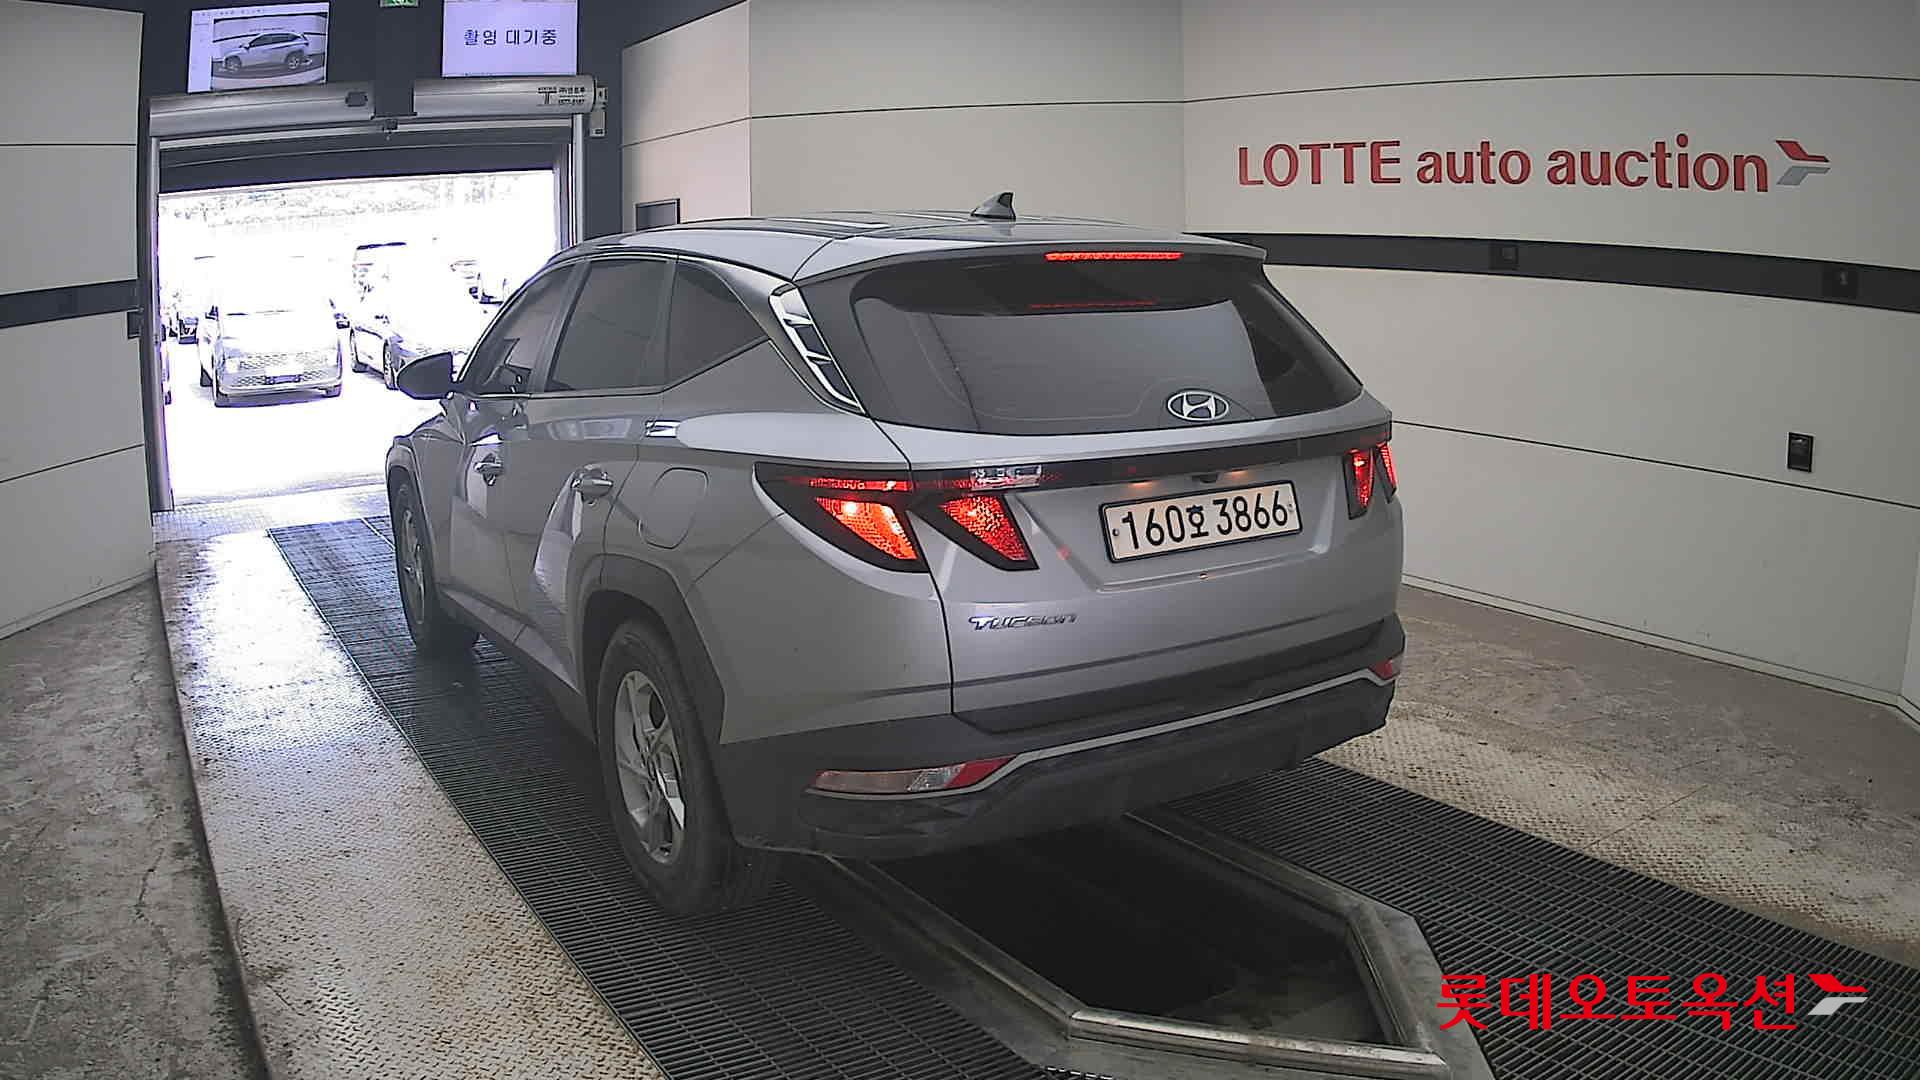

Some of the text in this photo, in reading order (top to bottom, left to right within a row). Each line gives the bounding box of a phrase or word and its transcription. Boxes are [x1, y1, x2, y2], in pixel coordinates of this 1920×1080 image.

[464, 29, 557, 46] 촬영 대기중
[1239, 133, 1769, 192] LOTTE auto auction
[1121, 490, 1289, 550] 160호 3866
